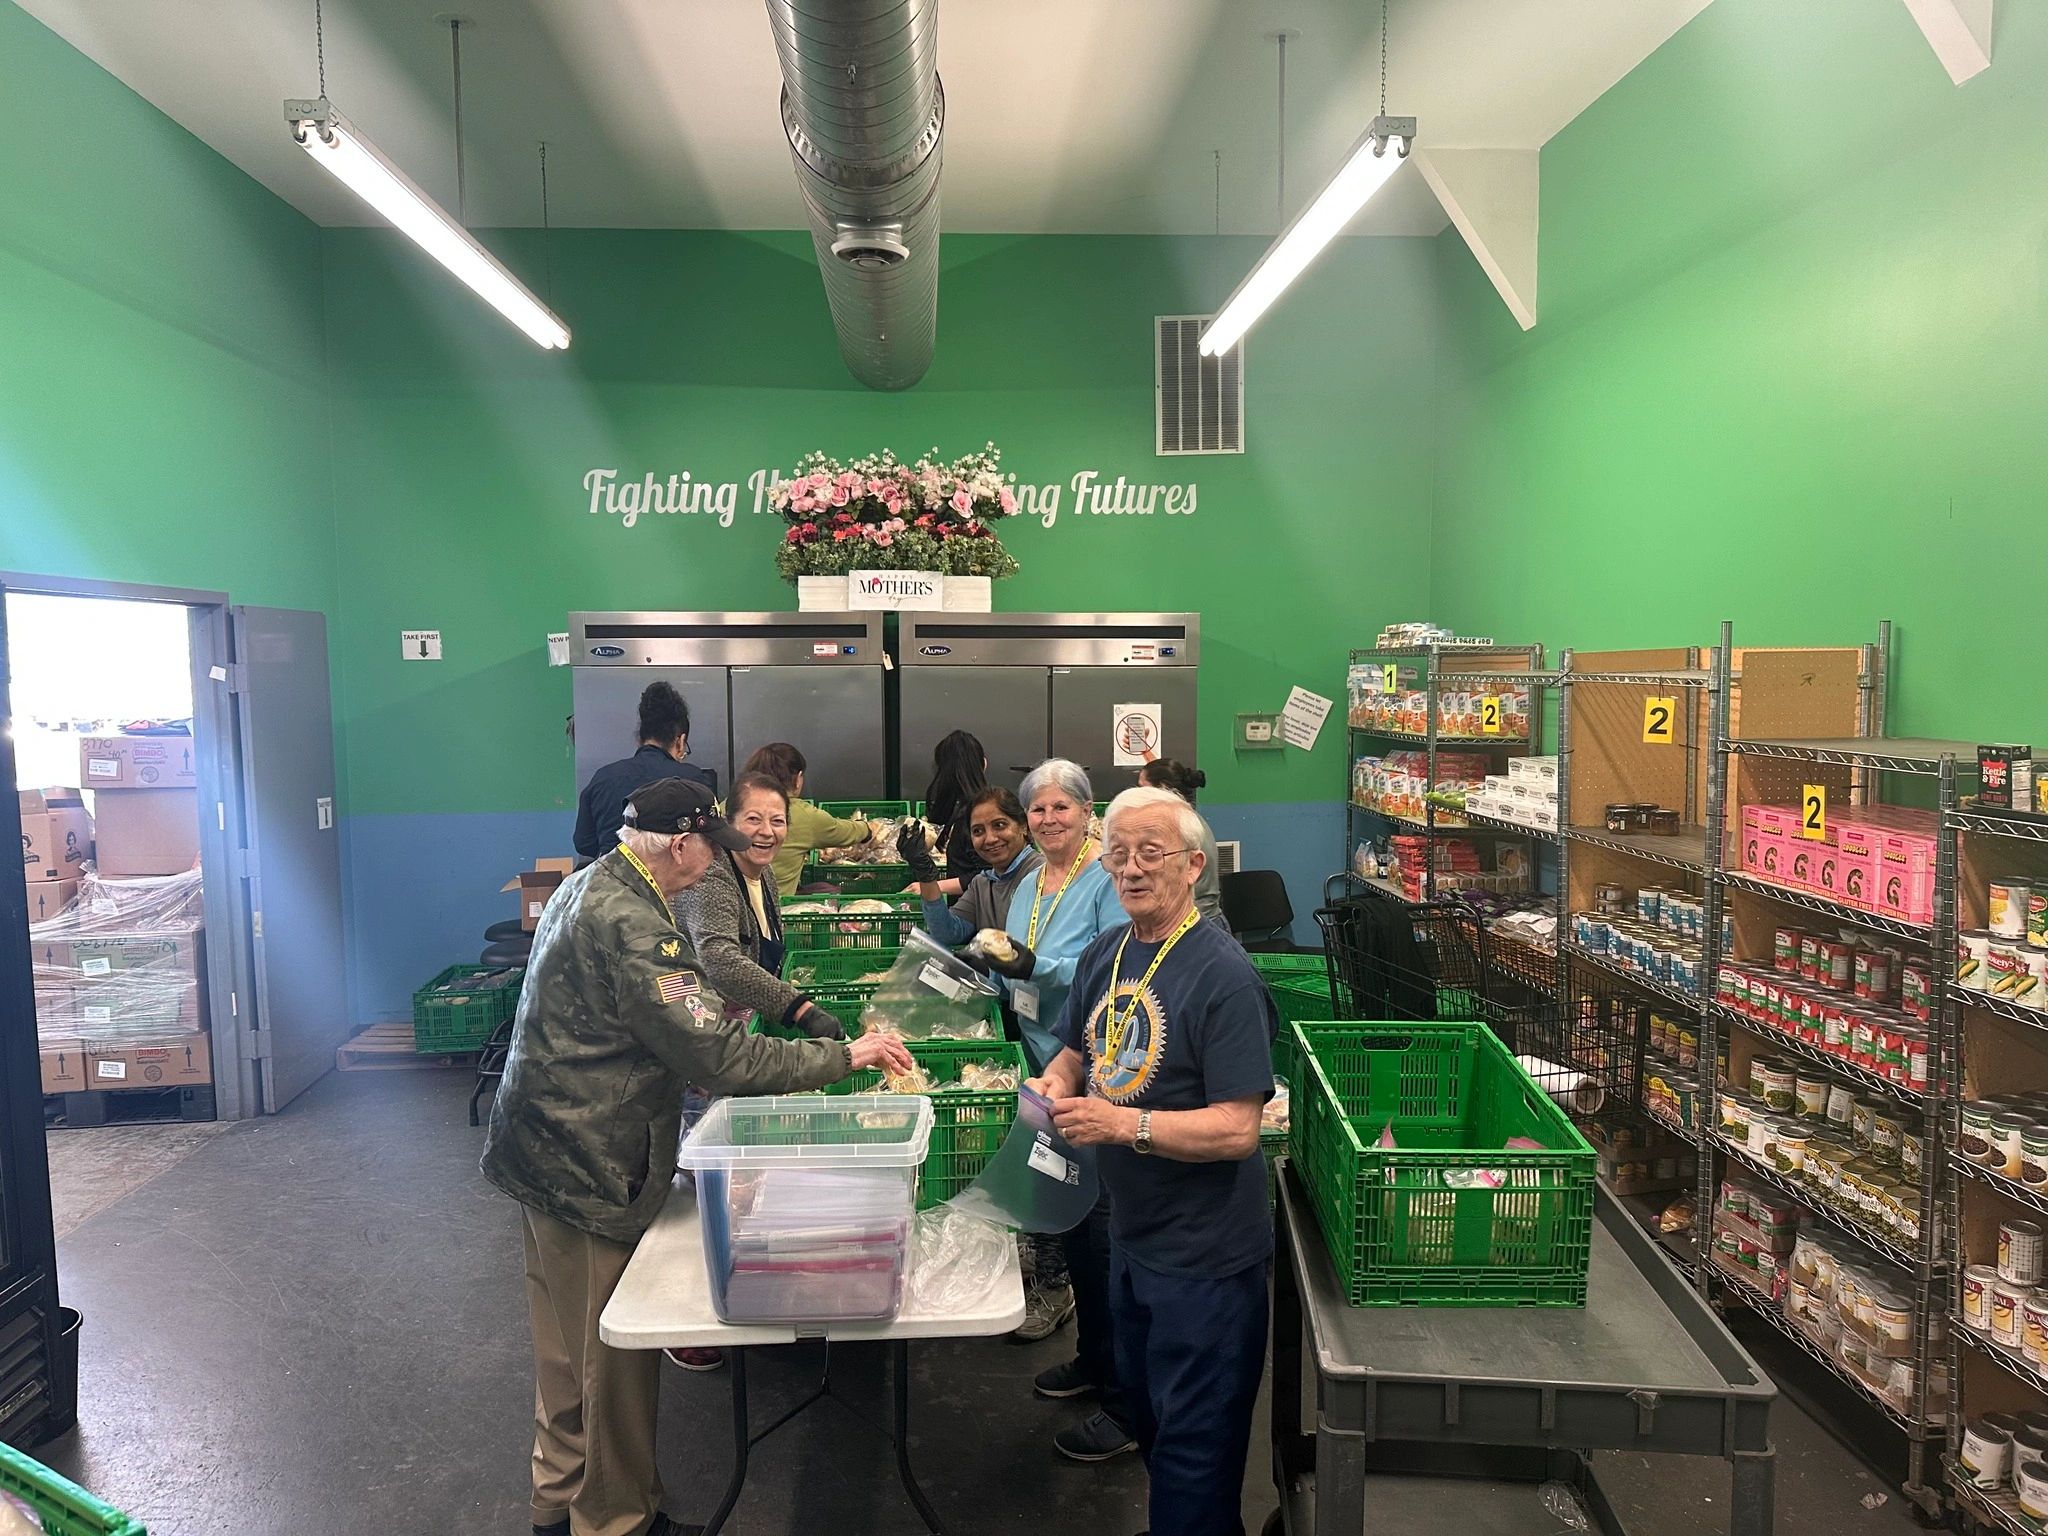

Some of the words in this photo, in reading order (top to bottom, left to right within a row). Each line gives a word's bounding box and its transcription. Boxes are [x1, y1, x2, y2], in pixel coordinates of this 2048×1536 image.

[583, 468, 738, 528] Fighting
[1071, 470, 1197, 515] Futures
[859, 579, 933, 595] MOTHER'S
[1386, 670, 1393, 688] 1
[1484, 704, 1496, 726] 2
[1648, 707, 1668, 735] 2
[1982, 766, 2007, 777] Kettle
[1982, 774, 1989, 783] &
[1989, 775, 2006, 785] Fire
[1806, 796, 1821, 830] 2
[1837, 895, 1858, 909] GLUTEN
[1858, 900, 1873, 911] FREE
[1897, 910, 1909, 920] FREE
[1159, 930, 1183, 957] VOLUNTEER
[1135, 967, 1154, 998] VOLUNTEER
[1115, 1008, 1133, 1041] VOLUNTEER
